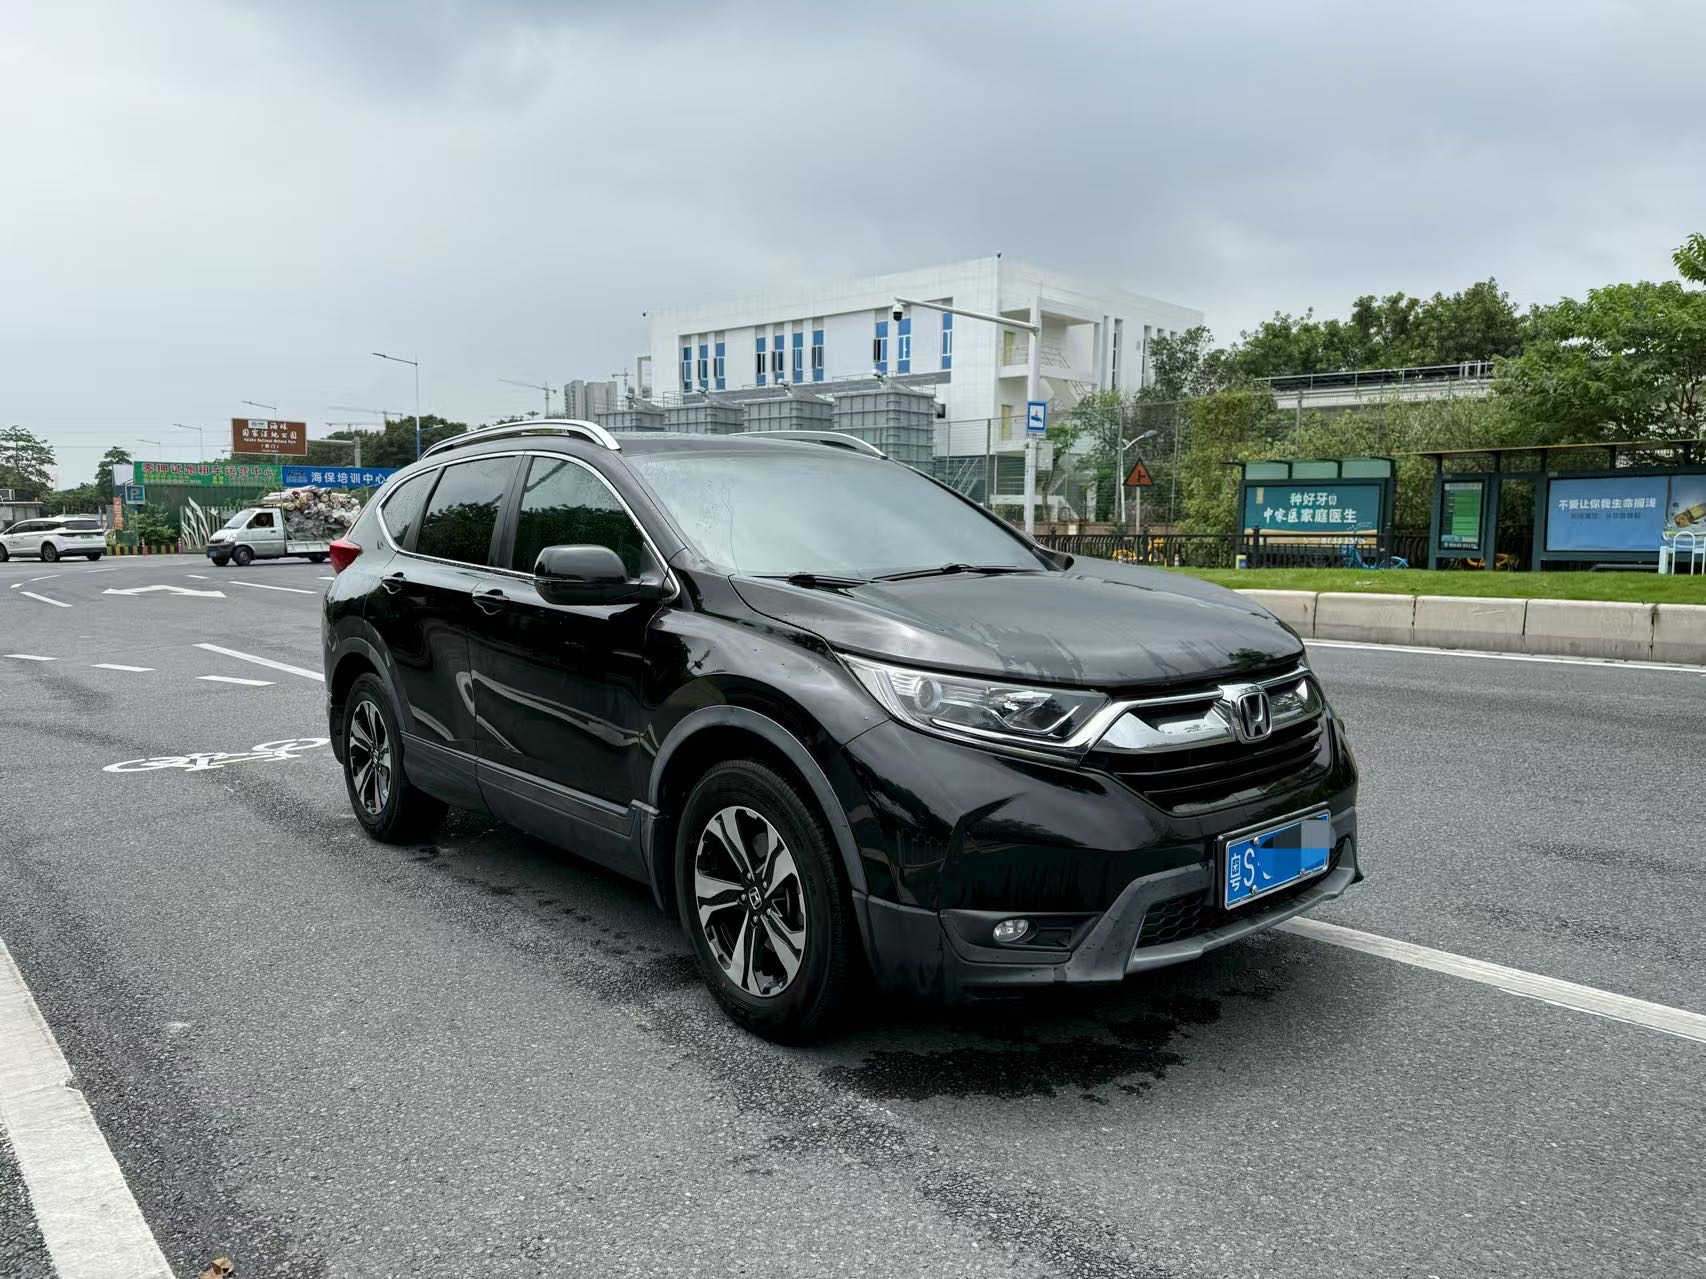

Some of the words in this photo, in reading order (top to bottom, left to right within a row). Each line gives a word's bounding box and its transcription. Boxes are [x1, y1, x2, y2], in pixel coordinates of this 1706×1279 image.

[311, 471, 387, 485] 海保培训中心
